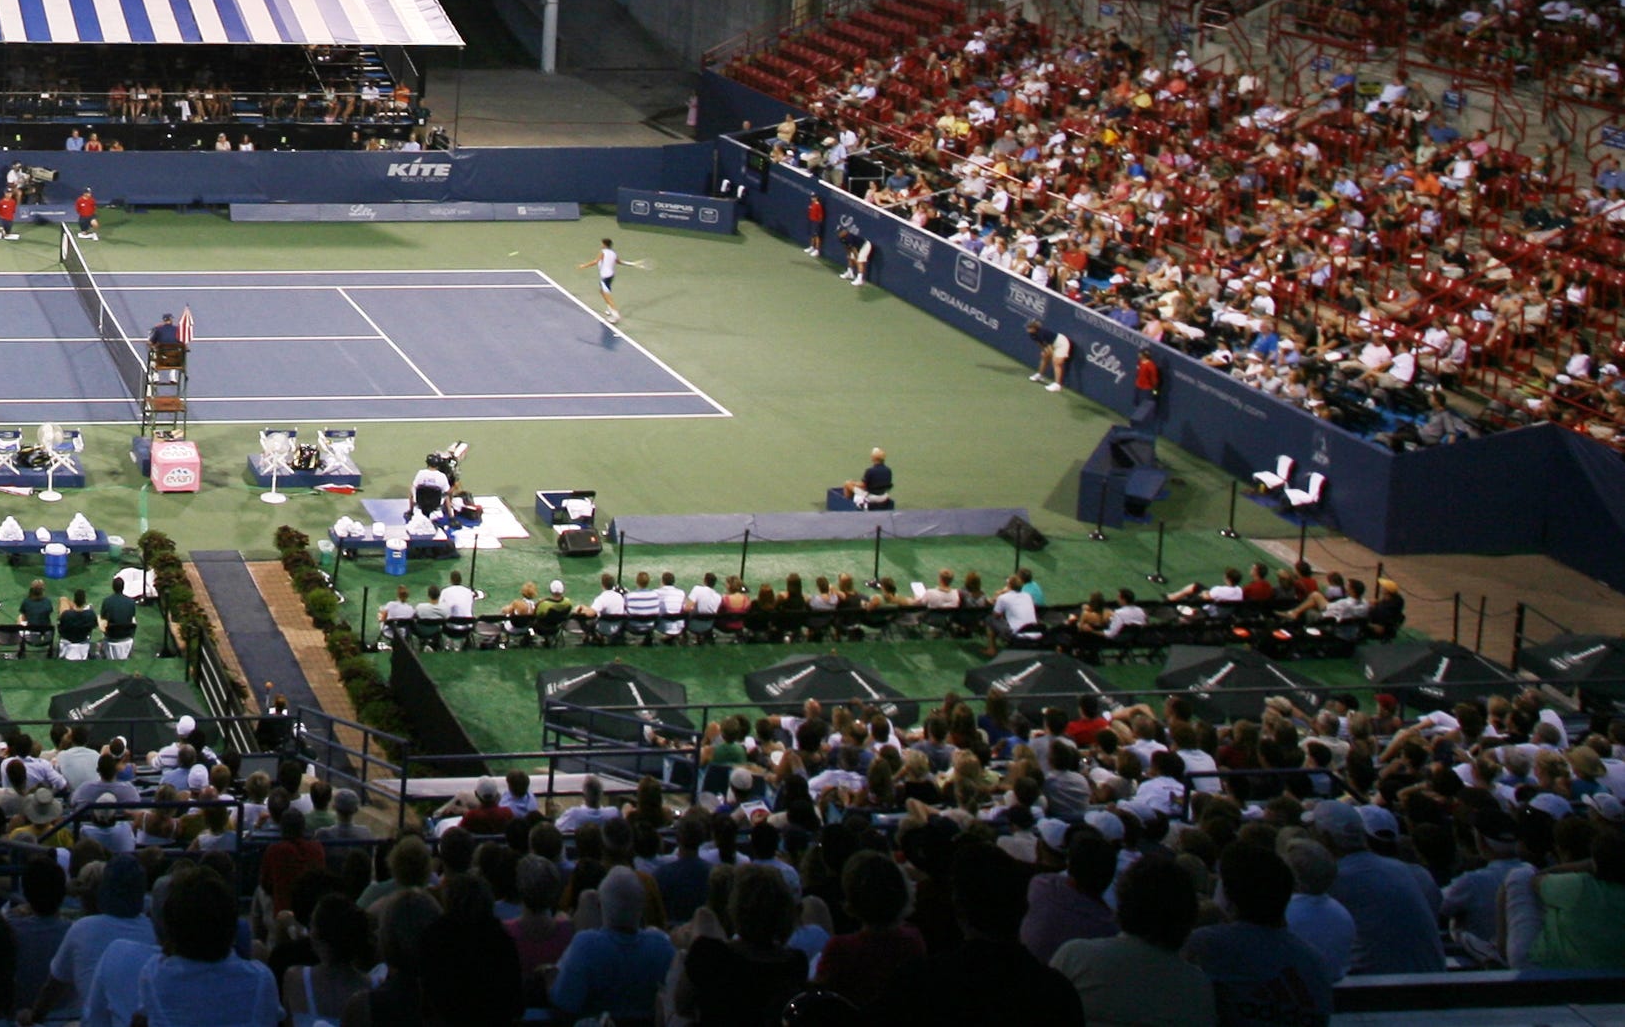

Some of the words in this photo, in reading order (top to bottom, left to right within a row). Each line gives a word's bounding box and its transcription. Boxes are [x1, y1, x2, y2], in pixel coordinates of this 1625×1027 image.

[387, 157, 452, 177] KITE
[654, 201, 694, 212] OLYMPUS
[929, 286, 999, 331] INDIANAPOLIS
[1085, 341, 1126, 384] Lilly
